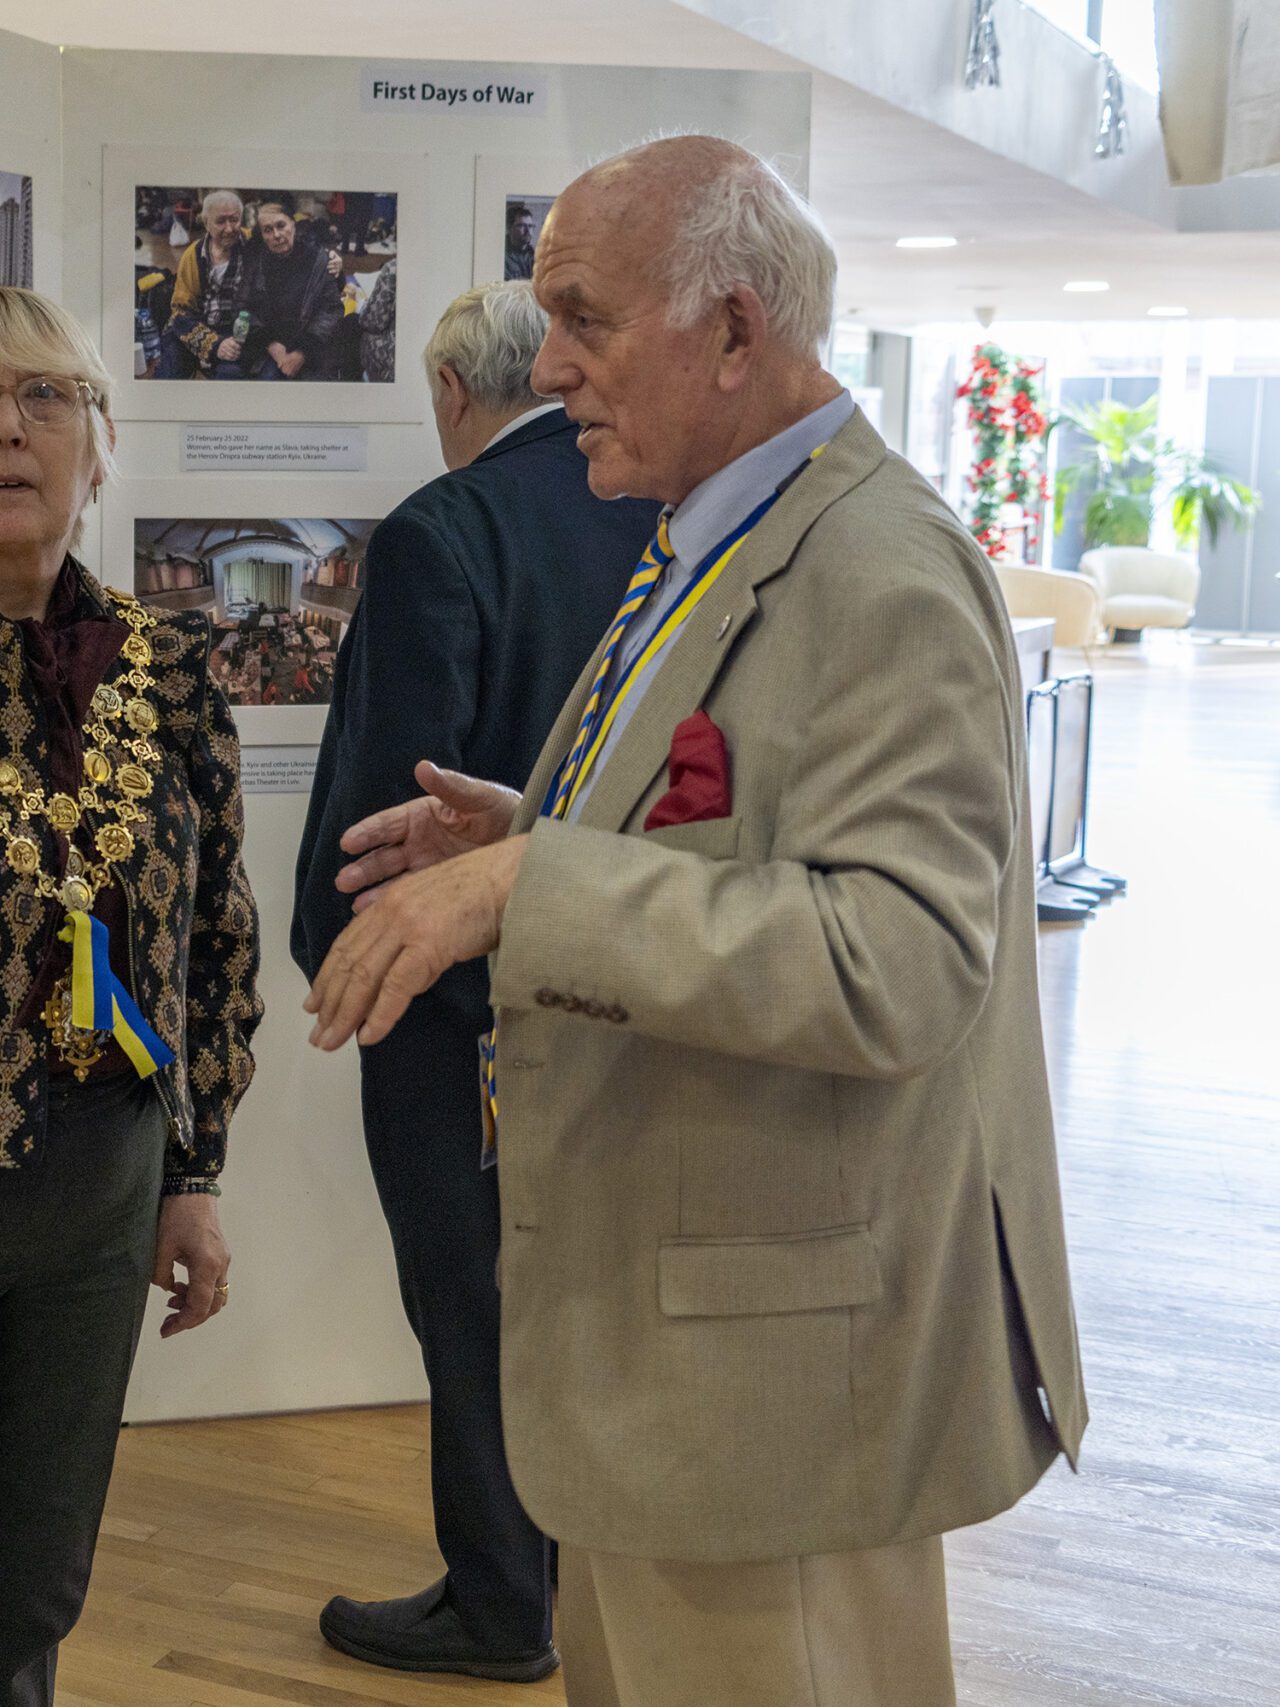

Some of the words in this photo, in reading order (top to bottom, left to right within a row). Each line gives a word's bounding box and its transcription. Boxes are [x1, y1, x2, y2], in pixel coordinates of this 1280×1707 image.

[373, 82, 416, 100] First
[422, 84, 468, 106] Days
[472, 85, 493, 102] of
[496, 86, 534, 104] War
[196, 434, 223, 443] February
